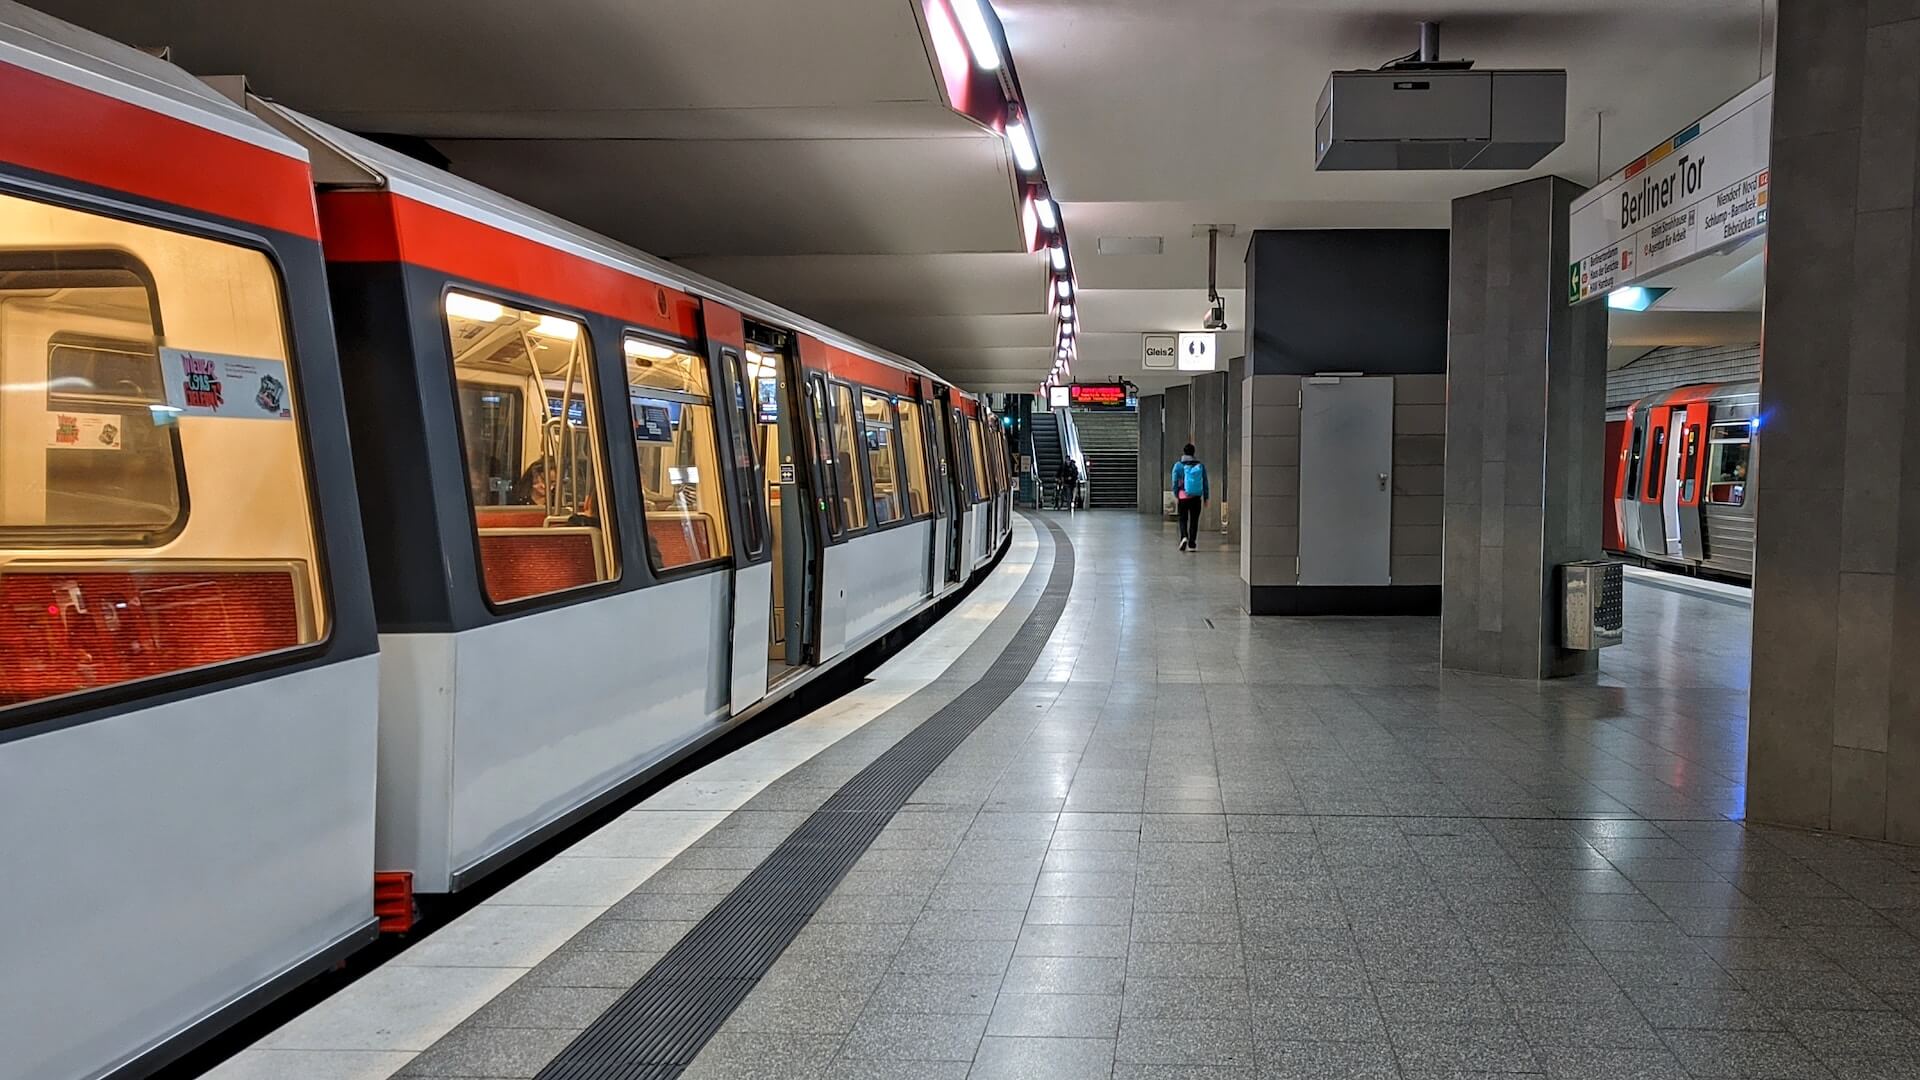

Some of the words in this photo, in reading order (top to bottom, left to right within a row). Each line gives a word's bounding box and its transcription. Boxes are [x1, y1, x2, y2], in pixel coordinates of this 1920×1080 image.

[1622, 173, 1676, 229] Berliner
[1679, 155, 1705, 198] Tor
[1716, 185, 1741, 208] Niendorf
[1742, 175, 1758, 196] Nord
[1705, 211, 1728, 230] Schlump
[1723, 216, 1756, 238] Elbbrücken
[1146, 347, 1168, 356] Gleis
[1168, 347, 1174, 356] 2
